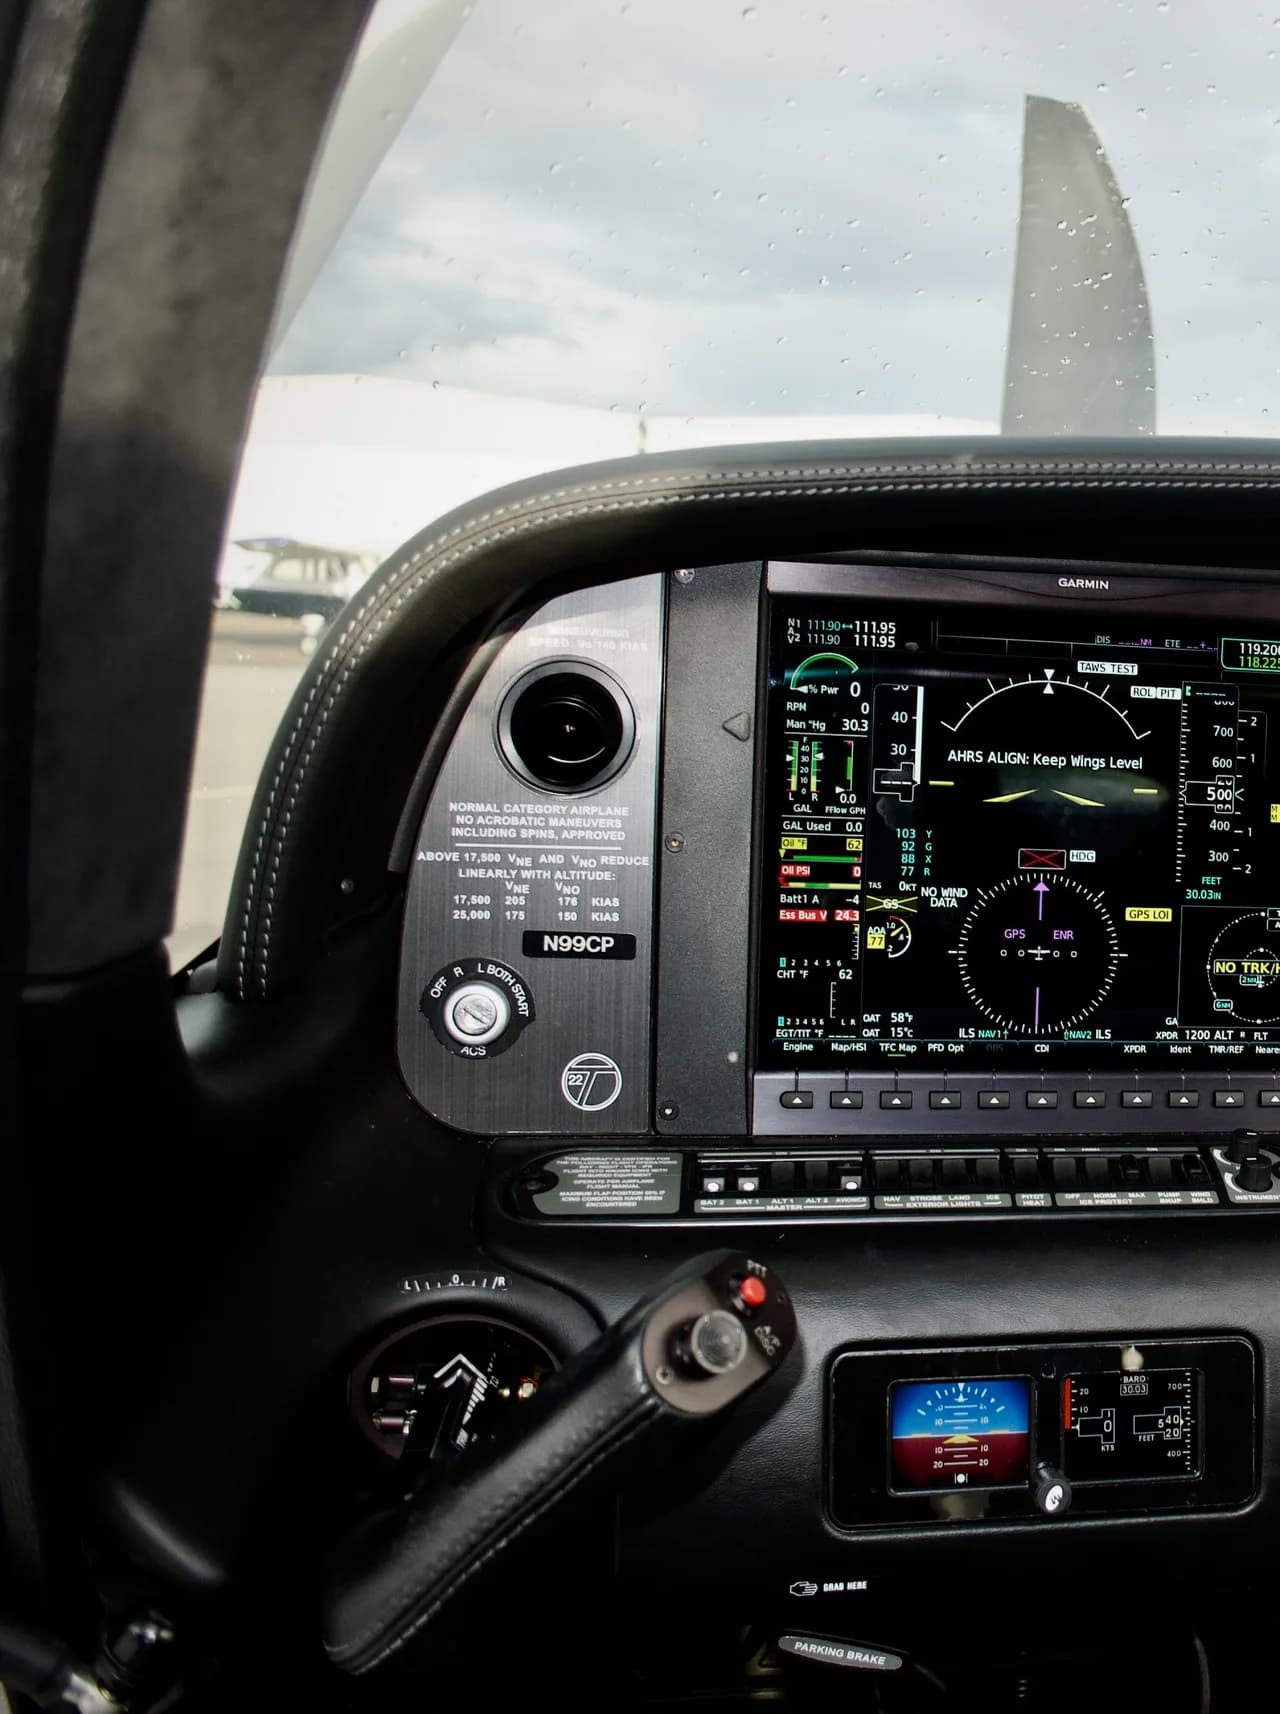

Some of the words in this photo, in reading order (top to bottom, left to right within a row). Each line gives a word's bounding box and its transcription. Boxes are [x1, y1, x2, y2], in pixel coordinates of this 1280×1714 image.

[1058, 578, 1109, 590] GARMIN
[808, 619, 840, 631] 111.90
[855, 620, 896, 634] 111.95
[808, 633, 840, 645] 111.90
[854, 635, 896, 648] 111.95
[1081, 663, 1106, 672] TAWS
[1110, 664, 1136, 674] TEST
[821, 685, 839, 695] Pwr
[850, 682, 861, 697] 0
[1133, 688, 1152, 697] ROL
[1160, 689, 1176, 698] PIT
[787, 702, 806, 711] RPM
[861, 703, 870, 714] 0
[787, 720, 805, 729] Man
[842, 719, 868, 731] 30.3
[1213, 725, 1233, 737] 700
[948, 750, 983, 763] AHRS
[988, 751, 1029, 765] ALIGN:
[1033, 753, 1066, 768] Keep
[1071, 755, 1106, 770] Wings
[1110, 757, 1142, 769] Level
[1212, 757, 1232, 768] 600
[1207, 787, 1232, 800] 500
[450, 802, 499, 812] NORMAL
[504, 803, 567, 814] CATEGORY
[570, 805, 629, 816] AIRPLANE
[456, 815, 474, 825] NO
[477, 816, 547, 827] ACROBATIC
[549, 818, 622, 828] MANEUVERS
[783, 821, 802, 830] GAL
[806, 822, 831, 831] Used
[846, 822, 862, 832] 0.0
[1209, 820, 1230, 831] 400
[452, 827, 517, 838] INCLUDING
[520, 829, 559, 841] SPINS,
[562, 830, 625, 841] APPROVED
[418, 851, 460, 862] ABOVE
[464, 853, 501, 864] 17,500
[540, 854, 564, 864] AND
[601, 855, 649, 866] REDUCE
[1071, 852, 1095, 861] HDG
[459, 869, 517, 879] LINEARLY
[521, 870, 551, 880] WITH
[554, 870, 616, 881] ALTITUDE:
[796, 866, 810, 875] PSI
[1202, 877, 1222, 885] FEET
[921, 887, 937, 896] NO
[941, 888, 968, 898] WIND
[454, 895, 491, 906] 17,500
[505, 896, 525, 906] 205
[557, 897, 578, 907] 176
[592, 897, 620, 907] KIAS
[930, 898, 958, 907] DATA
[453, 910, 491, 921] 25,000
[505, 911, 525, 920] 175
[558, 911, 577, 921] 150
[592, 912, 620, 922] KIAS
[780, 911, 795, 920] Ess
[799, 911, 816, 920] Bus
[820, 911, 827, 920] V
[835, 911, 859, 920] 24.3
[1129, 910, 1150, 919] GPS
[1153, 911, 1169, 920] LOI
[1004, 929, 1026, 939] GPS
[1053, 930, 1074, 940] ENR
[543, 934, 614, 953] N99CP
[453, 966, 464, 978] R
[477, 962, 485, 973] L
[1215, 962, 1236, 973] NO
[487, 964, 516, 986] BOTH
[430, 977, 448, 999] OFF
[512, 984, 529, 1016] START
[863, 1014, 880, 1022] OAT
[863, 1029, 880, 1037] OAT
[959, 1028, 975, 1038] ILS
[978, 1030, 1001, 1038] NAV1
[1069, 1030, 1092, 1039] NAV2
[1096, 1029, 1111, 1039] ILS
[1185, 1031, 1210, 1040] 1200
[1214, 1031, 1233, 1040] ALT
[1254, 1032, 1268, 1040] FLT
[461, 1046, 487, 1056] ACS
[783, 1042, 814, 1052] Engine
[831, 1042, 867, 1052] Map/HSI
[880, 1043, 896, 1052] TFC
[899, 1043, 917, 1054] Map
[928, 1044, 944, 1052] PFD
[948, 1043, 964, 1054] Opt
[1034, 1044, 1050, 1053] CDI
[1124, 1045, 1146, 1053] XPDR
[1170, 1046, 1191, 1054] Ident
[1209, 1045, 1244, 1054] TMR/REF
[569, 1075, 583, 1085] 22
[1123, 1376, 1146, 1384] BARO
[1122, 1385, 1146, 1393] 30.03
[794, 1642, 844, 1658] PARKING
[847, 1651, 886, 1665] BRAKE
